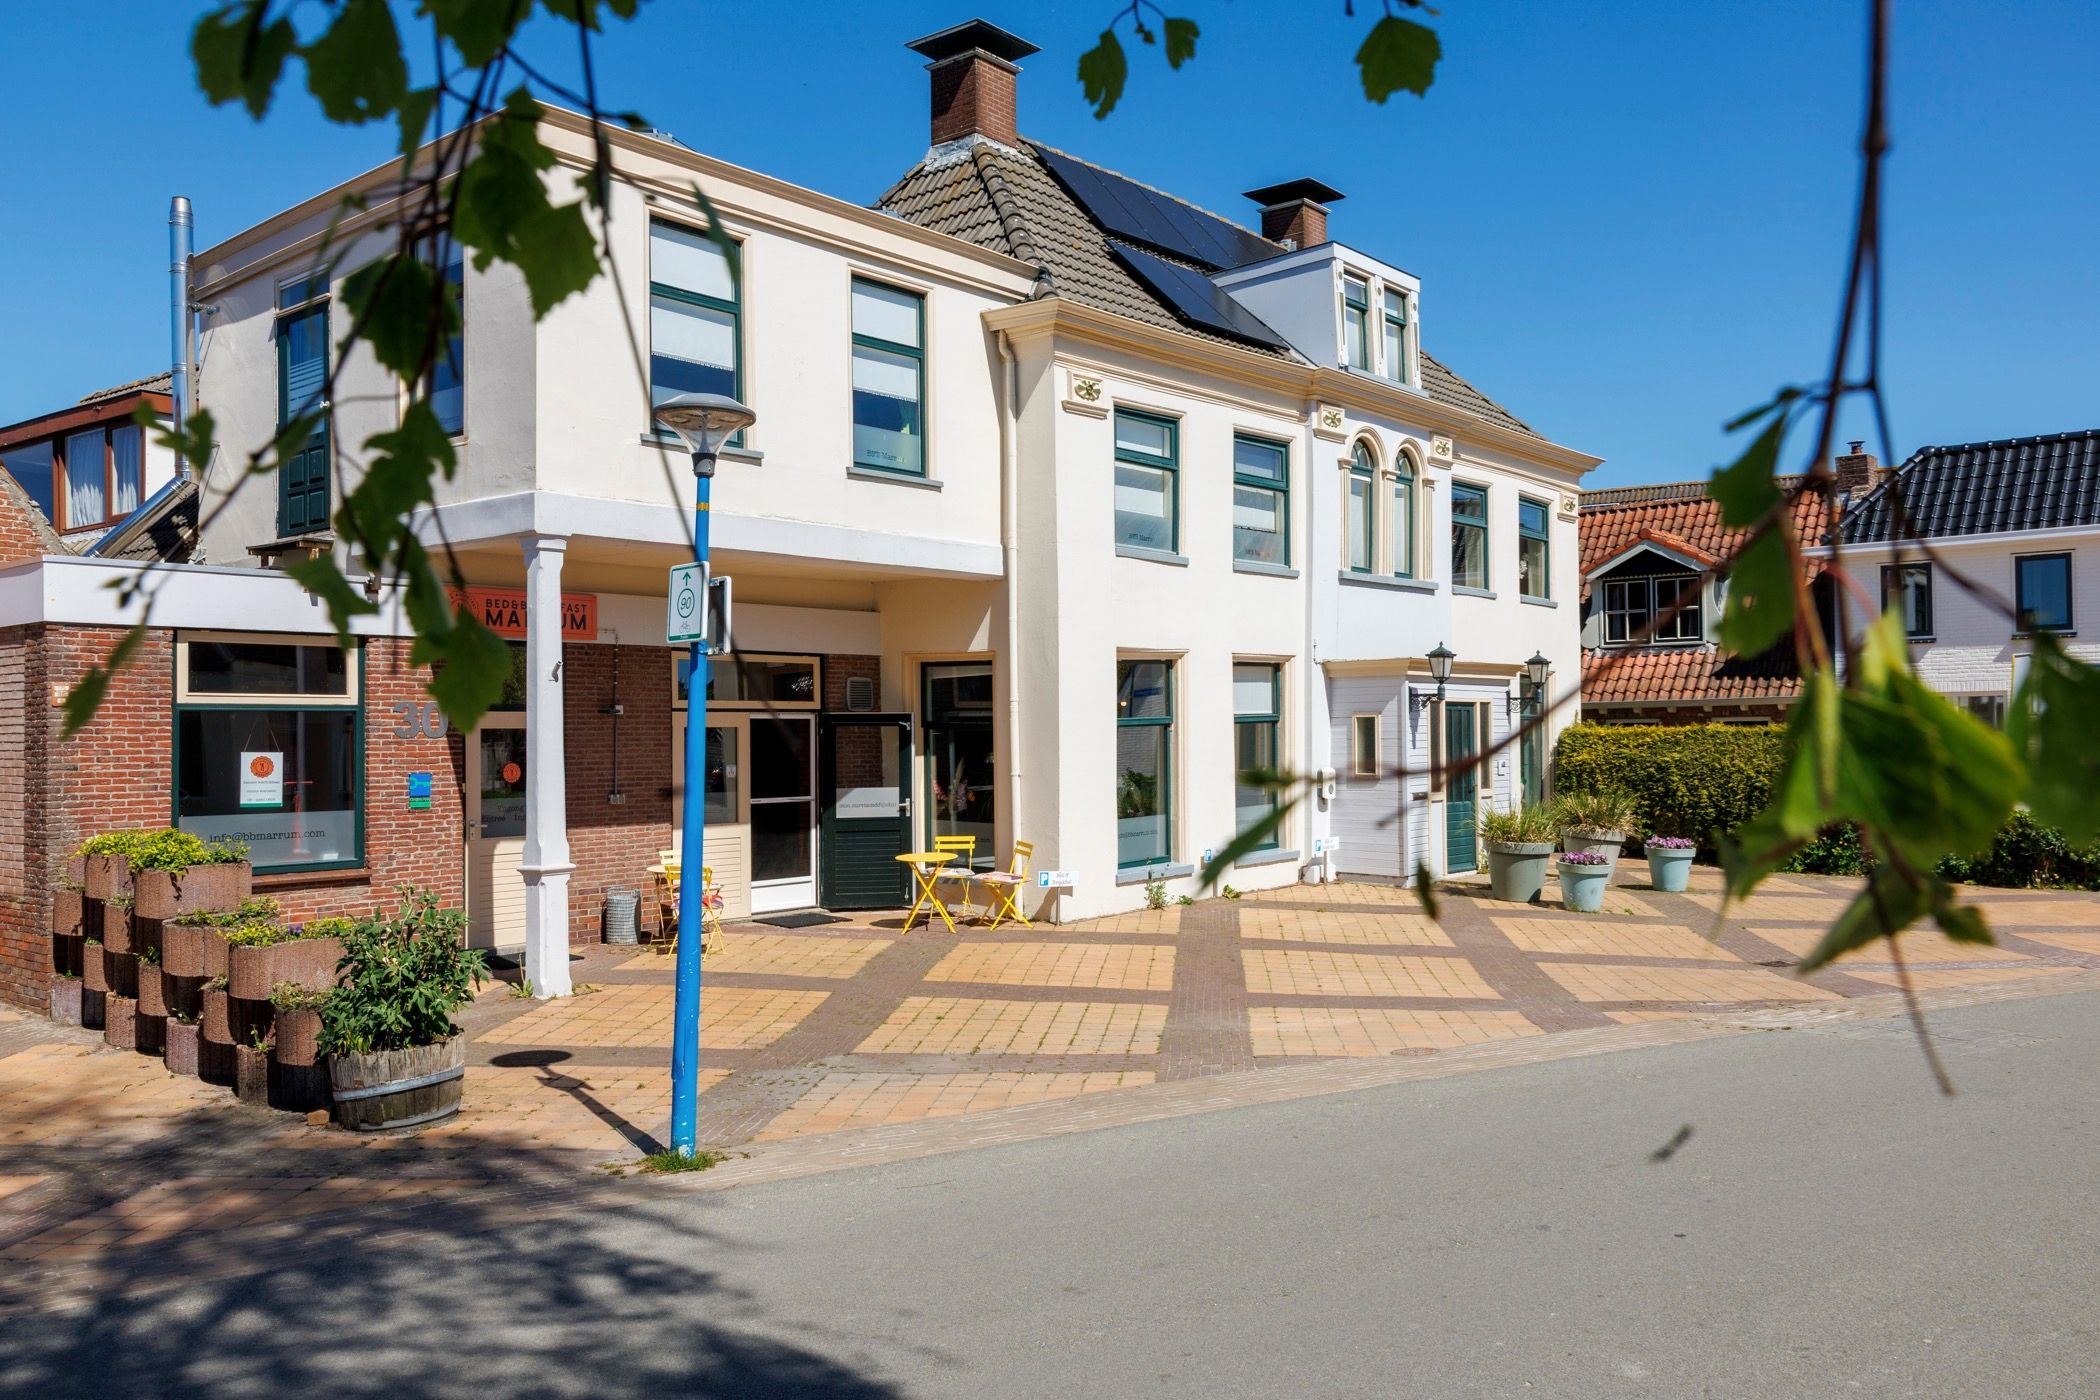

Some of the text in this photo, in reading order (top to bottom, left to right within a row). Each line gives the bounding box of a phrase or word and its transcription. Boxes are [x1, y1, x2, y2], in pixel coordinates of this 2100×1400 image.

[485, 598, 587, 614] BED&BFAST
[680, 597, 692, 610] 90
[485, 608, 587, 631] MAUM
[393, 702, 449, 739] 30
[209, 829, 326, 843] info@bbmarrum.com
